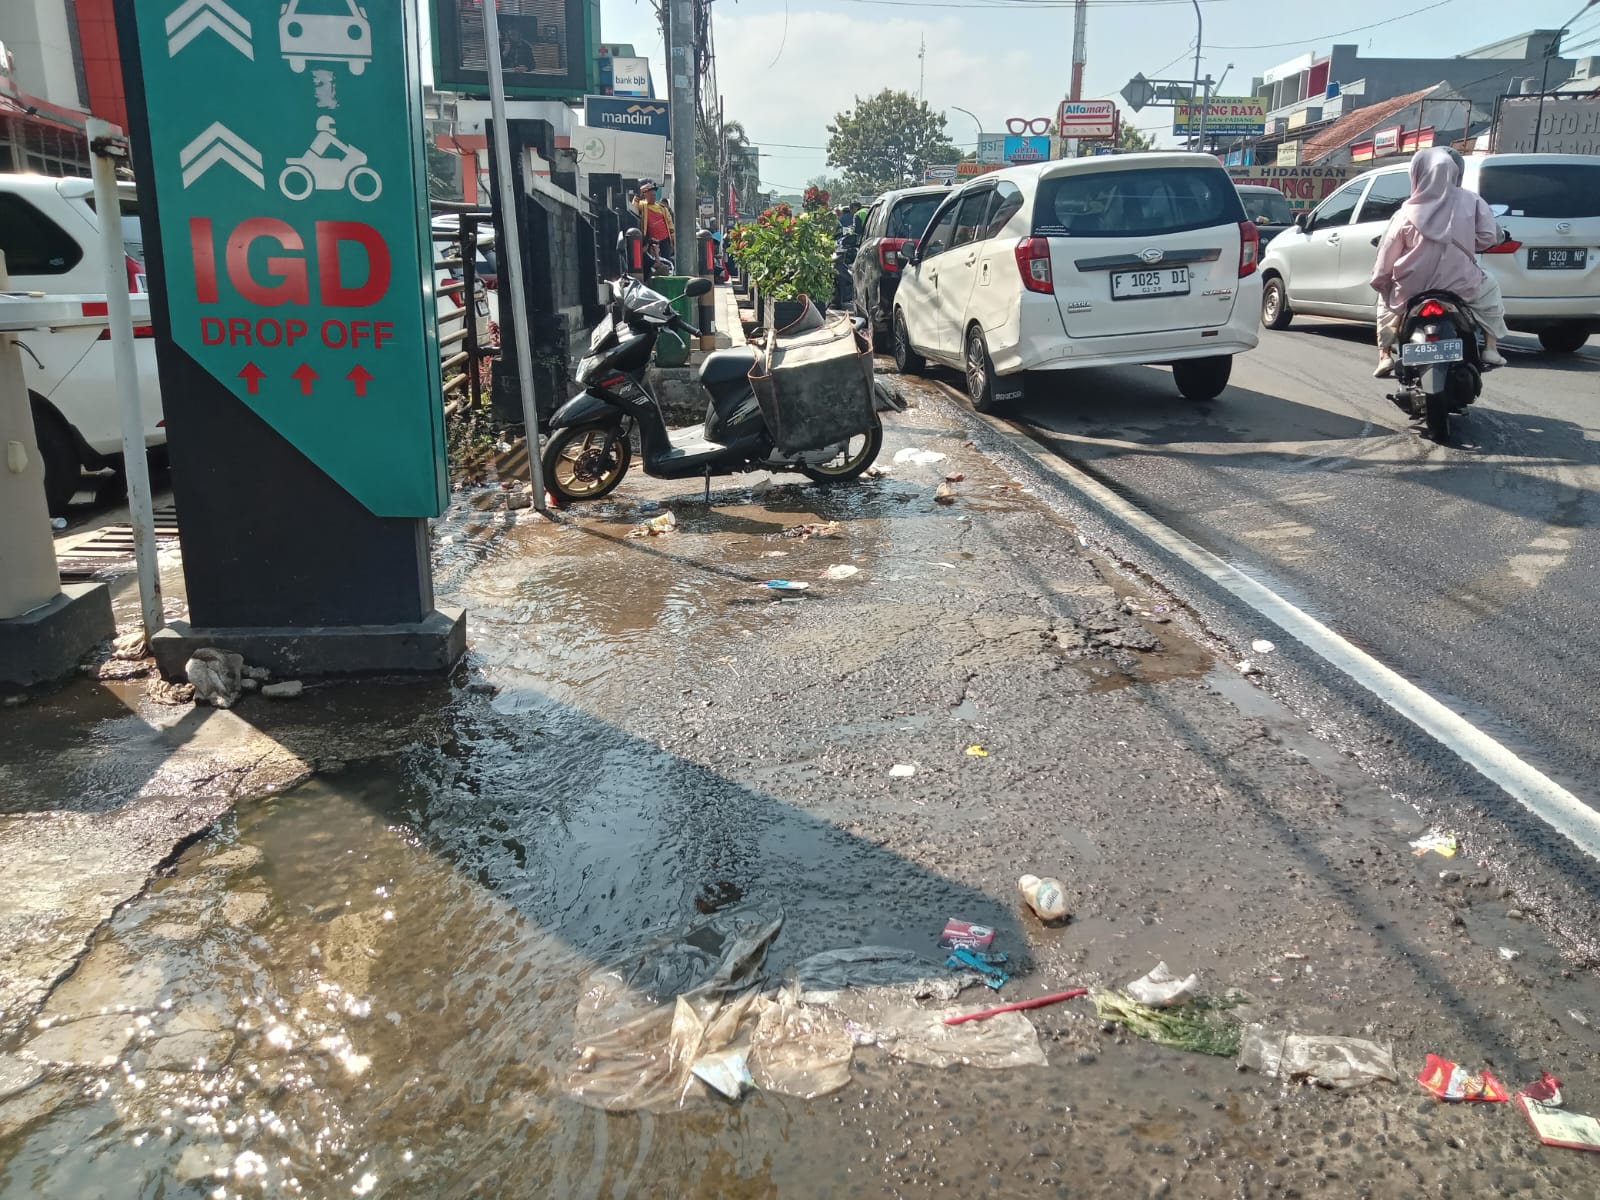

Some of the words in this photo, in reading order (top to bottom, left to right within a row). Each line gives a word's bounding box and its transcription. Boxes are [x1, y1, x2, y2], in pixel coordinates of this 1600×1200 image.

[615, 76, 632, 84] bank
[633, 76, 646, 86] bjb
[1065, 104, 1111, 114] Alfamart
[1179, 105, 1228, 116] MNNG
[1230, 105, 1263, 116] RAYA
[602, 112, 652, 125] mandiri
[981, 142, 997, 152] BSI
[958, 165, 978, 174] JAVA
[1261, 168, 1346, 177] HIDANGAN
[1532, 250, 1539, 262] F
[1548, 250, 1568, 262] 1320
[1574, 250, 1585, 262] NP
[189, 216, 392, 307] IGD
[1115, 275, 1122, 289] F
[1131, 272, 1160, 287] 1025
[1172, 270, 1187, 284] DI
[201, 316, 308, 347] DROP
[320, 319, 394, 349] OFF
[1404, 346, 1411, 355] F
